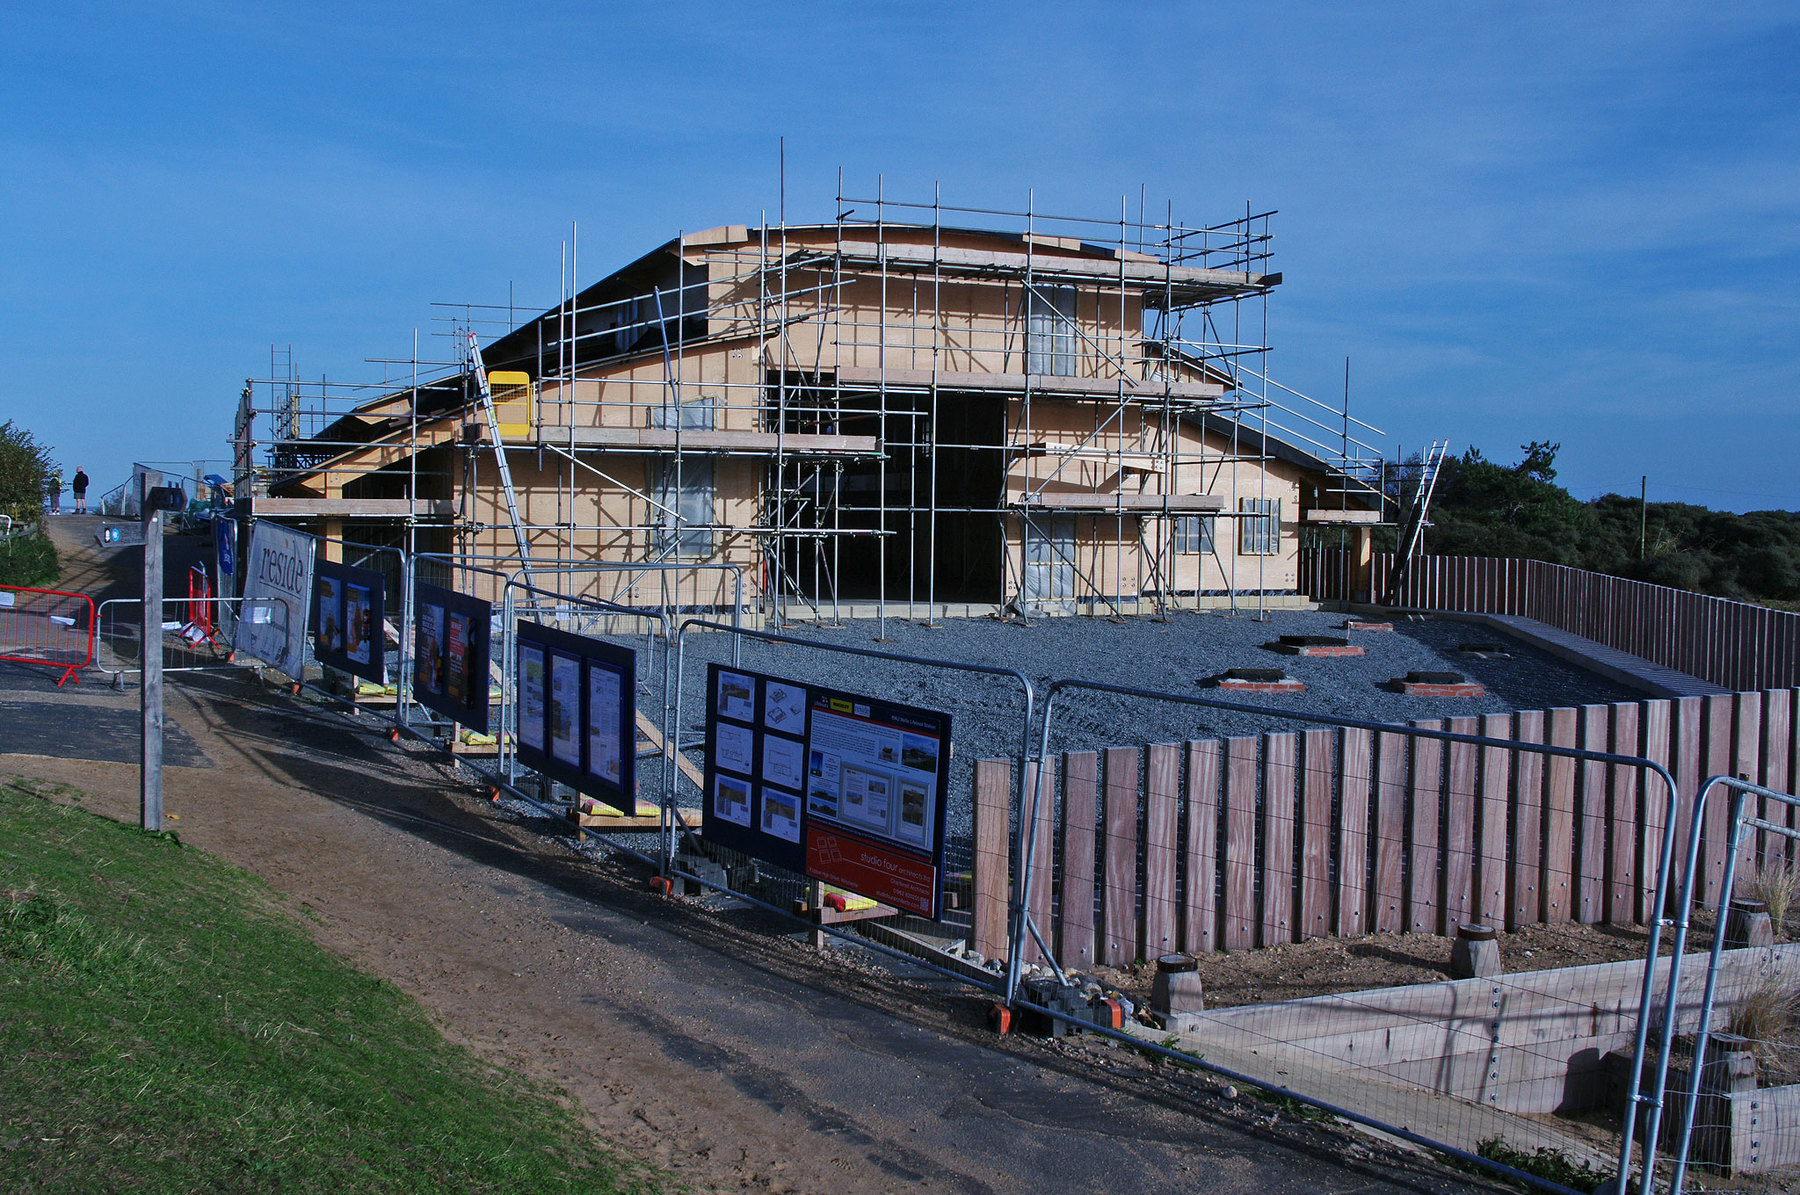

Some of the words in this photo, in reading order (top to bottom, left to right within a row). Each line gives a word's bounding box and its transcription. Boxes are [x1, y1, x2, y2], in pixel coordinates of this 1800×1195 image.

[259, 539, 304, 594] reside
[860, 853, 882, 867] studio
[883, 859, 898, 872] four
